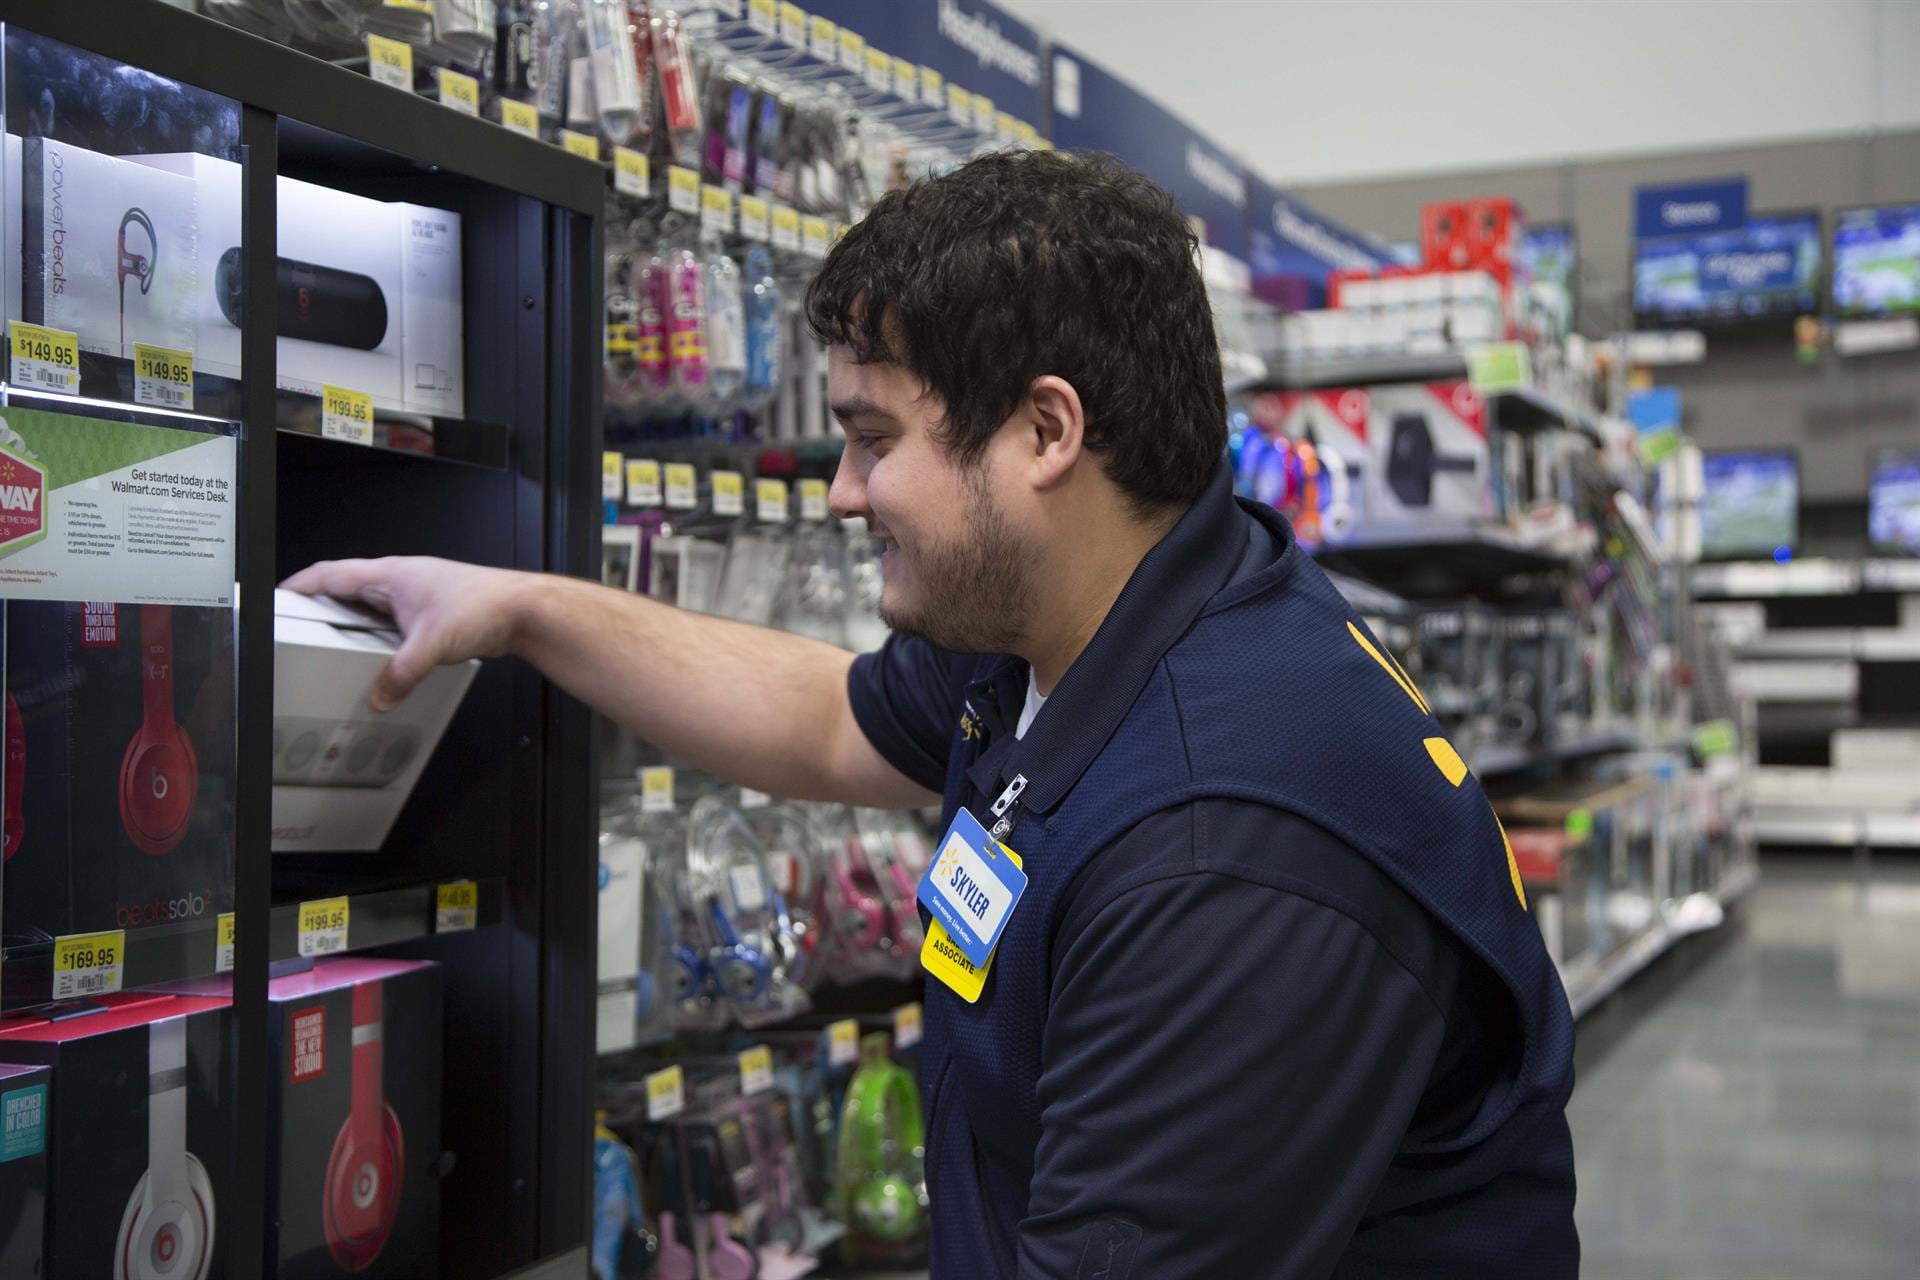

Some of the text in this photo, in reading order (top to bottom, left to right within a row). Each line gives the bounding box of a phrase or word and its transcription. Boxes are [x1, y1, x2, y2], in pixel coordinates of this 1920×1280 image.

[20, 339, 73, 365] $149.95
[142, 361, 189, 383] $149.95
[328, 399, 366, 420] $199.95
[131, 469, 229, 489] Get started today at the
[111, 481, 228, 503] Walmart.com Services Desk.
[85, 601, 115, 614] SOUND
[85, 627, 116, 642] EMOTION
[950, 866, 990, 920] SKYLER
[63, 947, 114, 970] $169.95
[934, 940, 976, 974] ASSOCIATE
[295, 1052, 321, 1076] STUDIO
[7, 1093, 41, 1114] DRENCHED
[16, 1109, 41, 1130] COLOR
